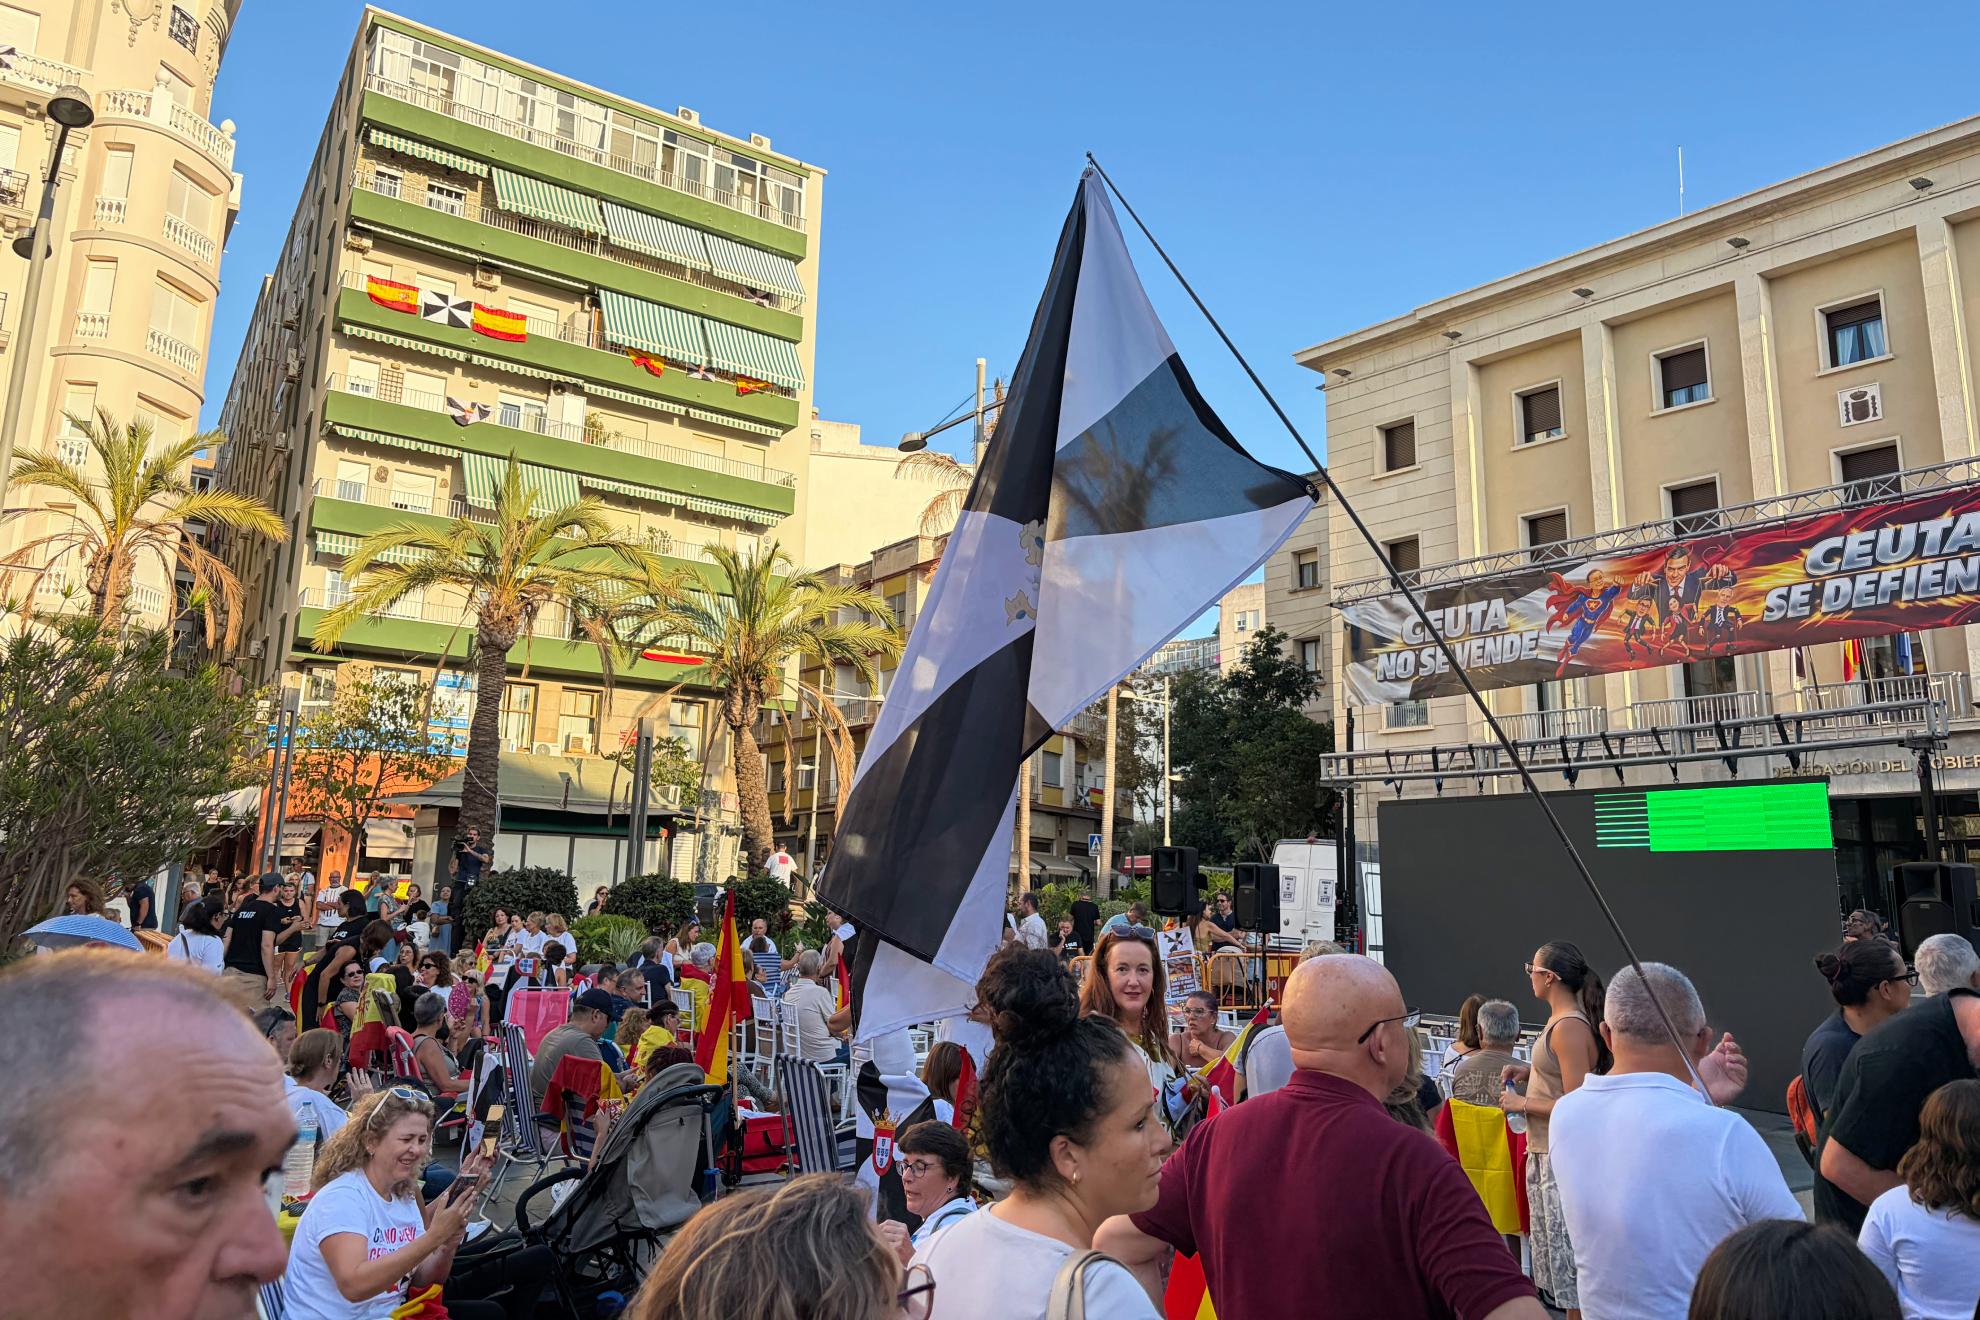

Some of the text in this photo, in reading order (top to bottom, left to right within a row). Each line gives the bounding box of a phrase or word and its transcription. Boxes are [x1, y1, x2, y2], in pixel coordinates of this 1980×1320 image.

[1805, 511, 1980, 576] CEUTA
[1401, 597, 1510, 645] CEUTA
[1762, 582, 1813, 622] SE
[1376, 630, 1540, 682] NO SE VENDE
[1879, 759, 1912, 774] DEL
[1930, 753, 1980, 770] OBIER
